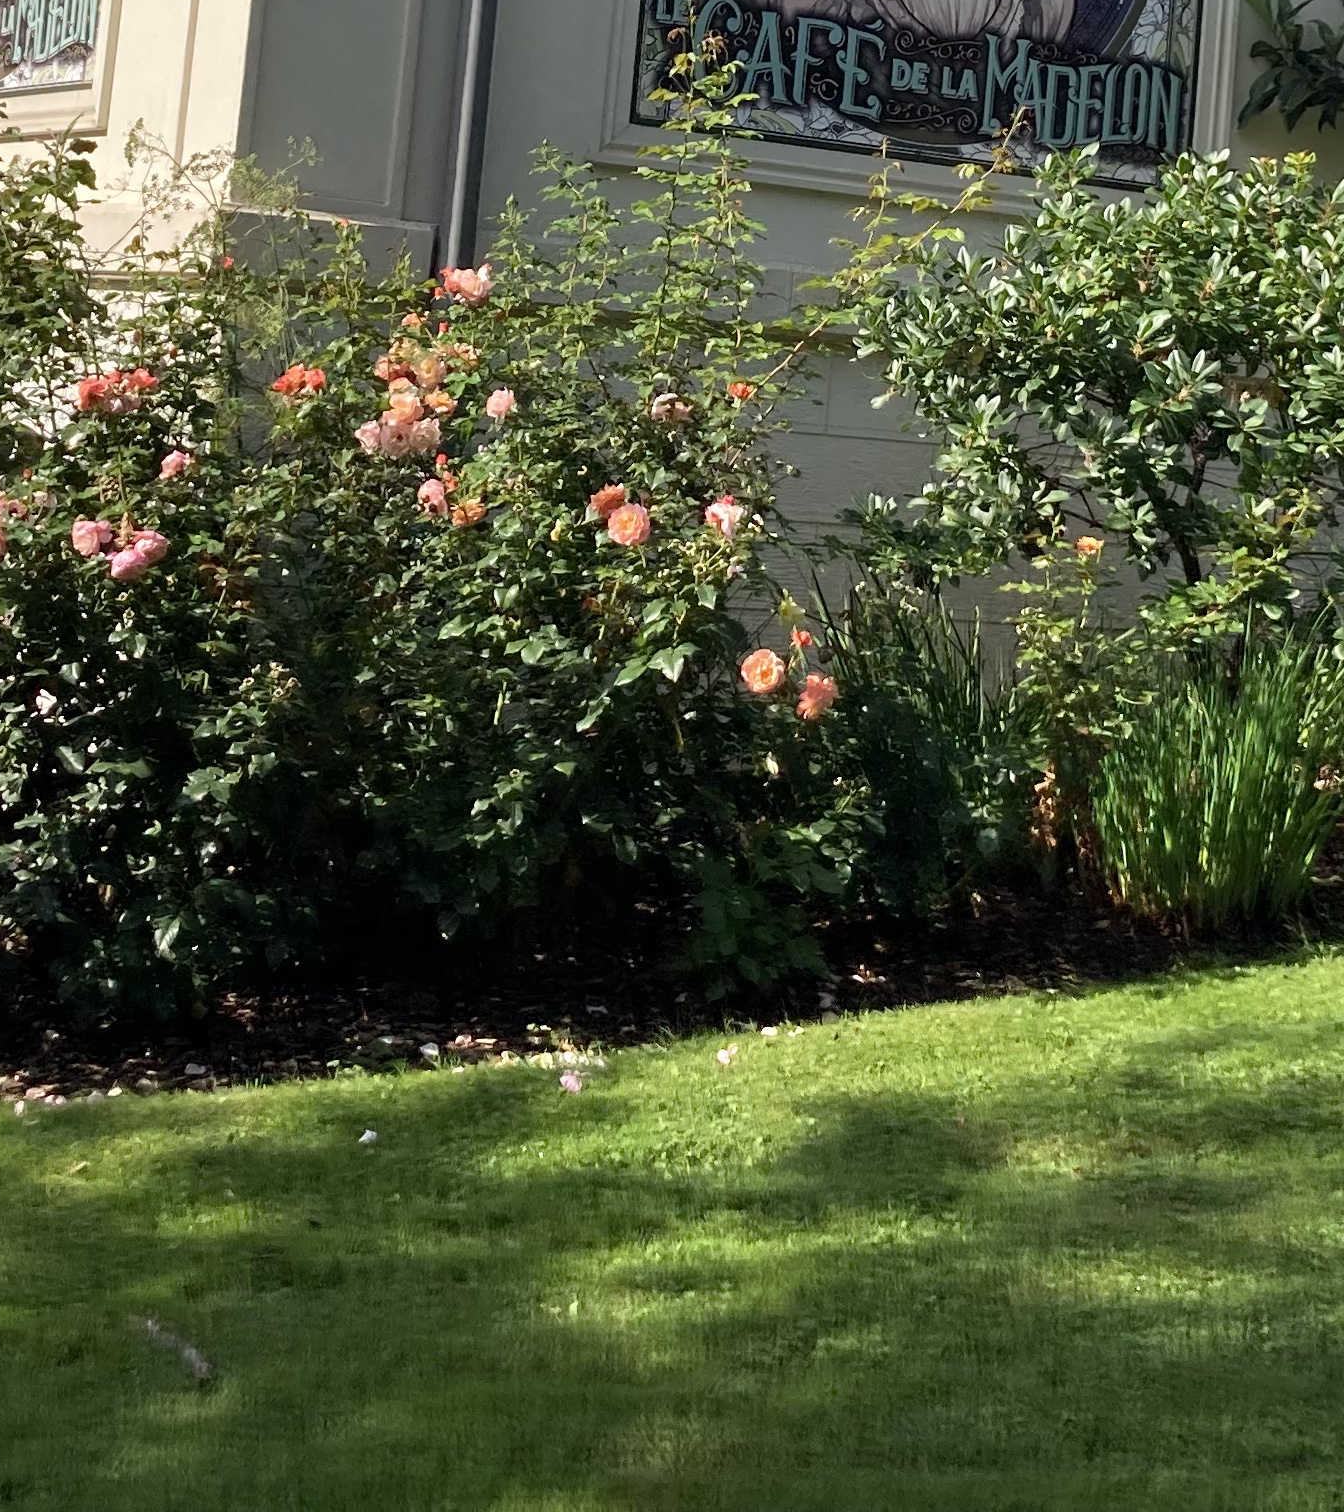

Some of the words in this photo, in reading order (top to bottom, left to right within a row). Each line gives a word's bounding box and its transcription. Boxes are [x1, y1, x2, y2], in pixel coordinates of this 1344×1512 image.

[0, 4, 16, 37] LA
[890, 58, 931, 94] DE
[940, 66, 979, 102] LA
[978, 33, 1184, 154] MADELON
